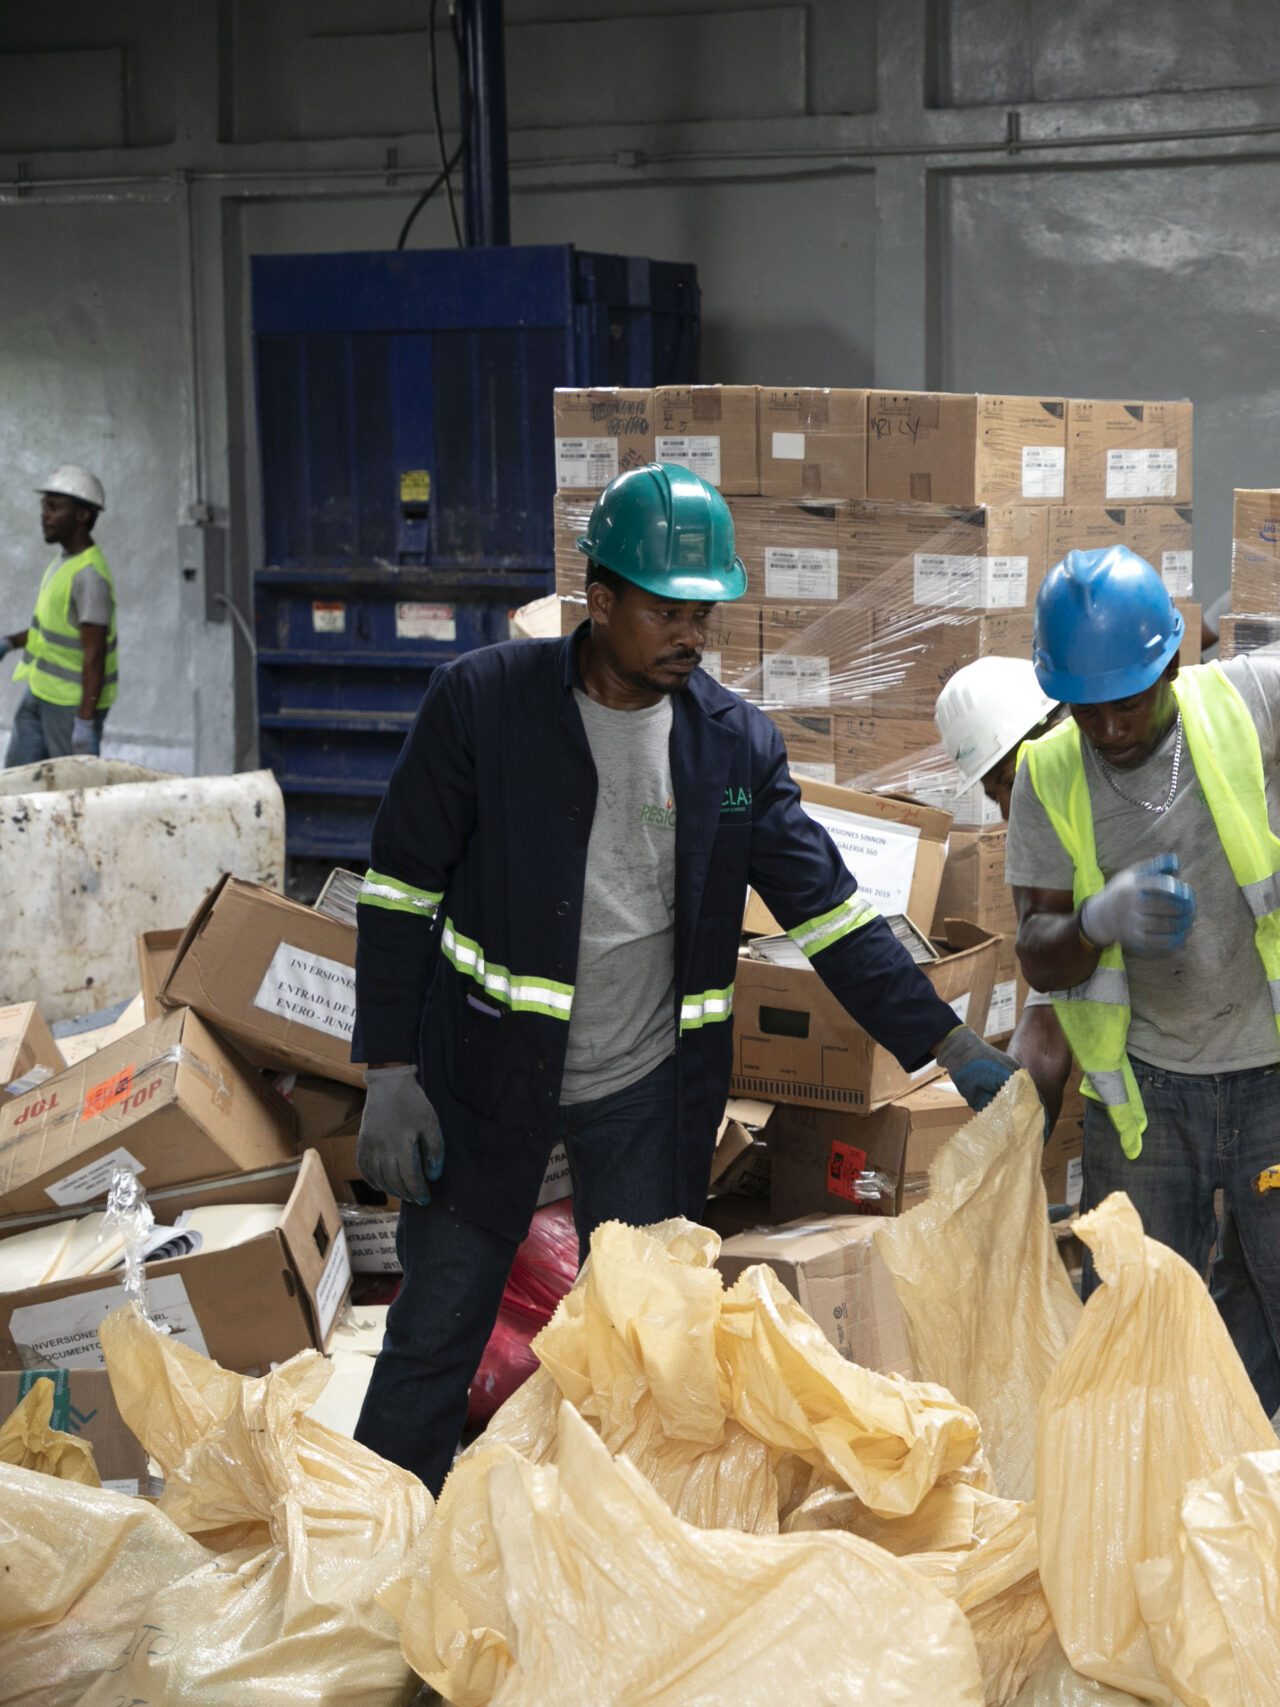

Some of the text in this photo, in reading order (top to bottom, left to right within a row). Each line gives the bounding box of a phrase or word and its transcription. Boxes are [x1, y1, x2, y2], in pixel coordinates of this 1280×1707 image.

[861, 833, 887, 845] SINNON
[836, 841, 878, 857] GALERIA 360
[875, 889, 891, 898] 2019
[277, 981, 349, 1014] ENTRADA DE
[275, 997, 316, 1019] ENERO
[120, 1078, 162, 1116] TOP
[13, 1092, 59, 1126] TOP
[543, 1168, 571, 1184] JULIO
[379, 1230, 390, 1239] DE
